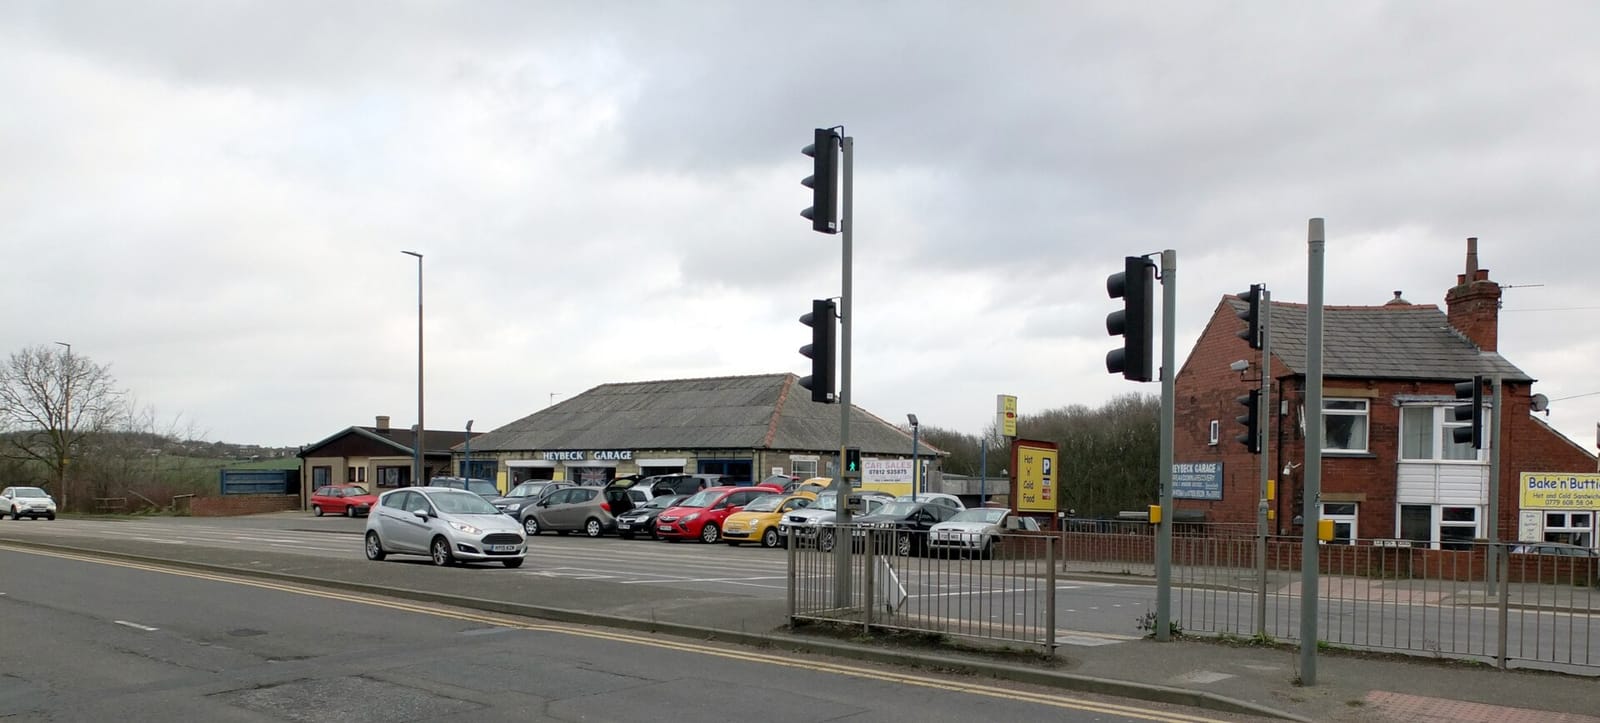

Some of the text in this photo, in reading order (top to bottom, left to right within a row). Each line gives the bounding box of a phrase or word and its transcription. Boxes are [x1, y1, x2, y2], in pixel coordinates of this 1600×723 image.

[543, 450, 632, 460] HEYBECK GARAGE
[1024, 455, 1033, 464] Hot
[885, 461, 912, 469] SALES
[1043, 458, 1050, 474] P
[1194, 463, 1216, 473] GARAGE
[1023, 480, 1034, 489] Cold
[1528, 476, 1600, 489] Bake'n'Butti
[1023, 492, 1035, 503] Food
